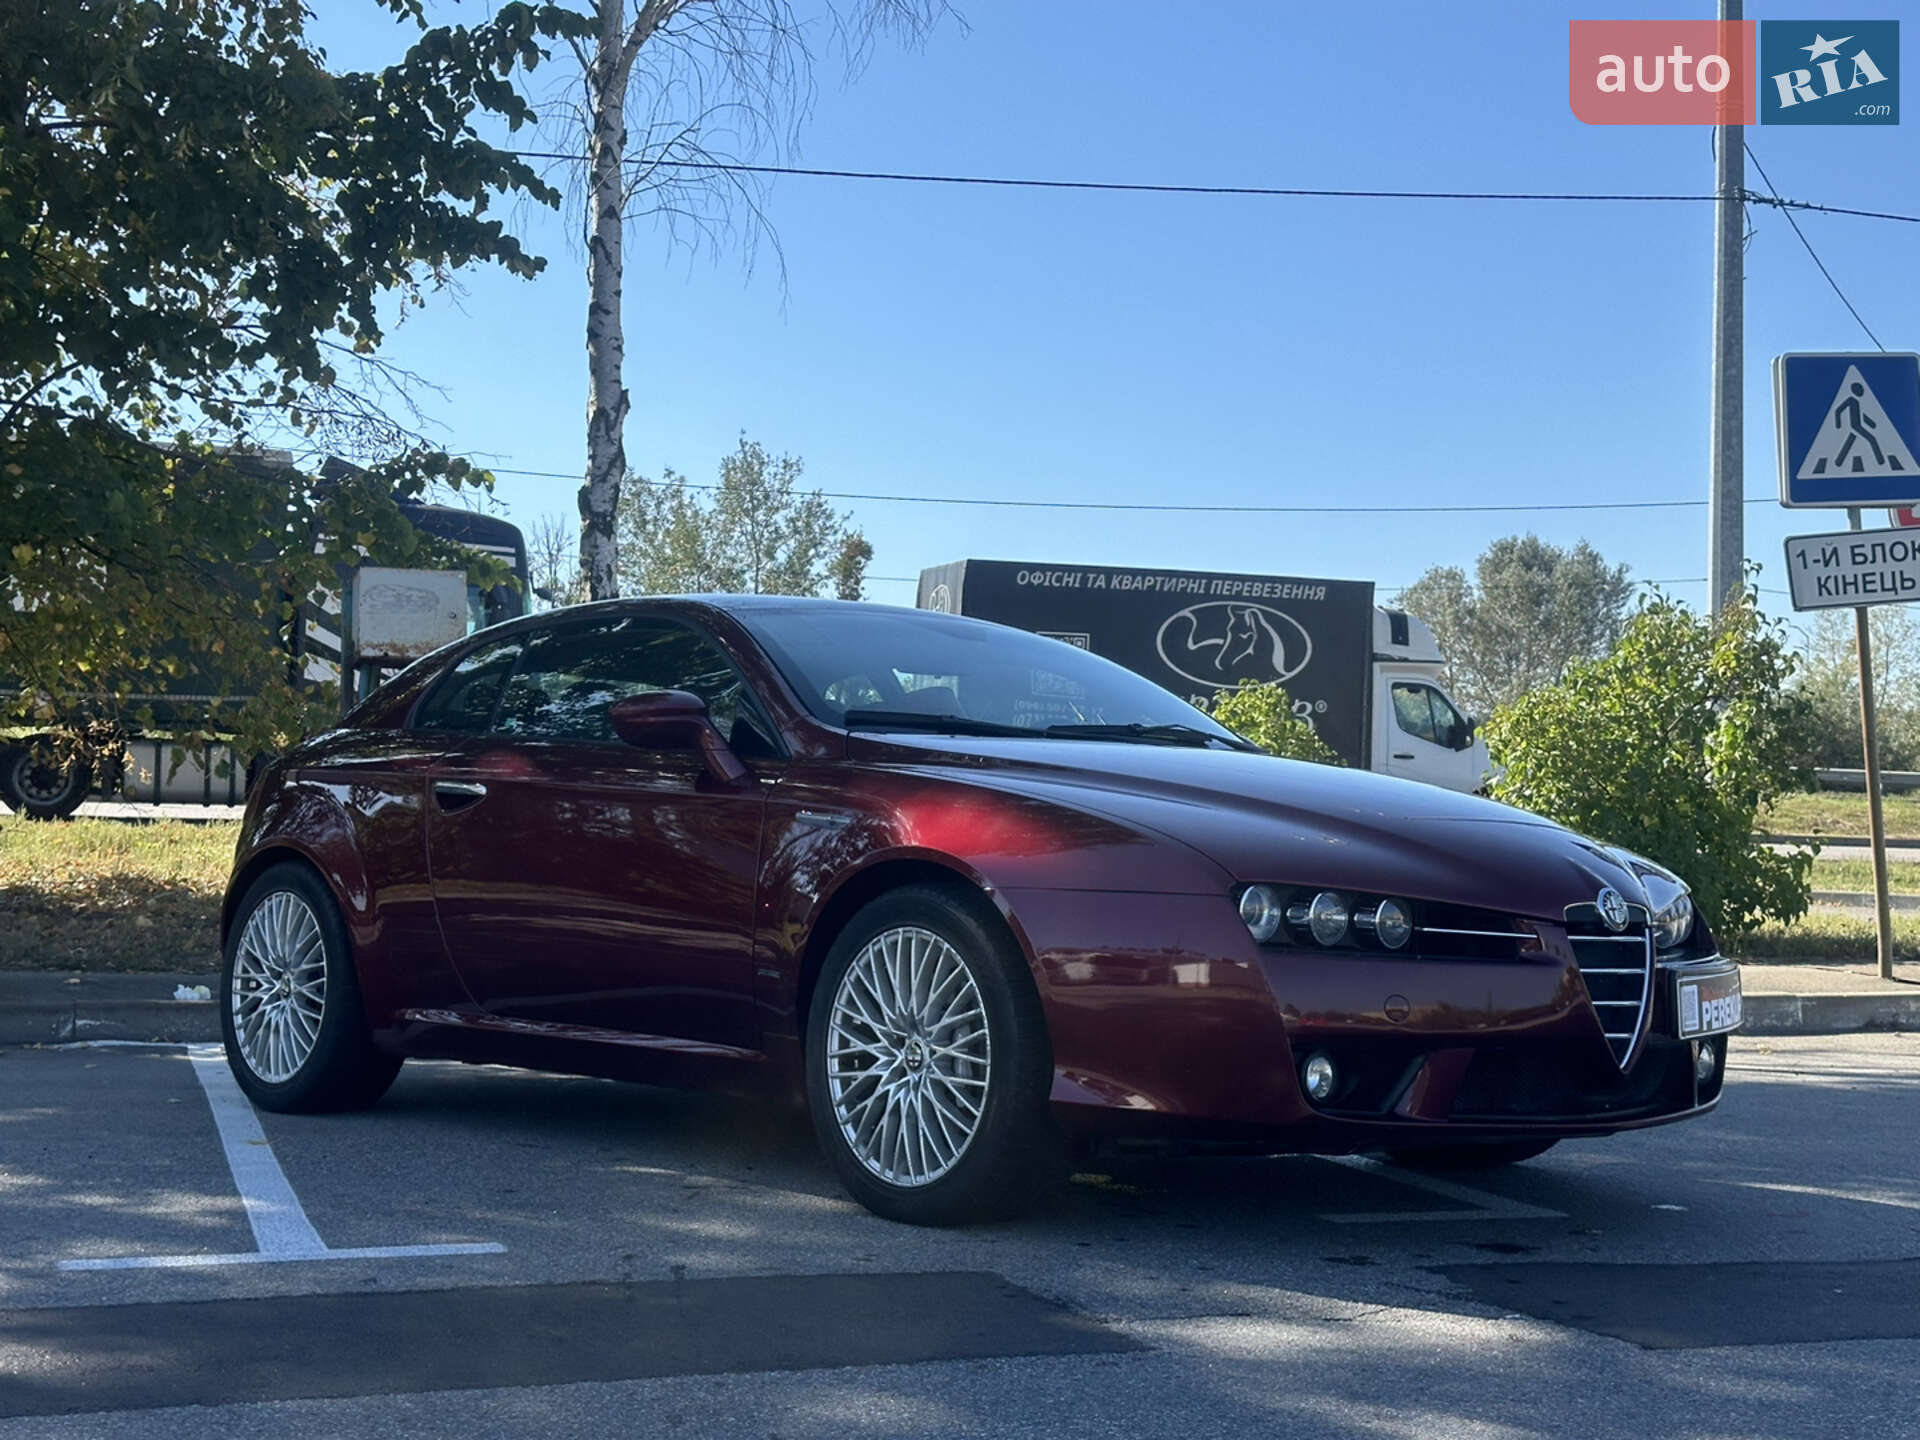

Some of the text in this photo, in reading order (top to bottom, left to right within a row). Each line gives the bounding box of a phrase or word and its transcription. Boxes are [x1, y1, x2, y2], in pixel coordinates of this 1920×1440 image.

[1796, 542, 1841, 570] 1-Й
[1016, 570, 1327, 600] ОФІСНІ ТА КВАРТИРНІ ПЕРЕВЕЗЕННЯ
[1816, 569, 1917, 597] КІНЕЦЬ
